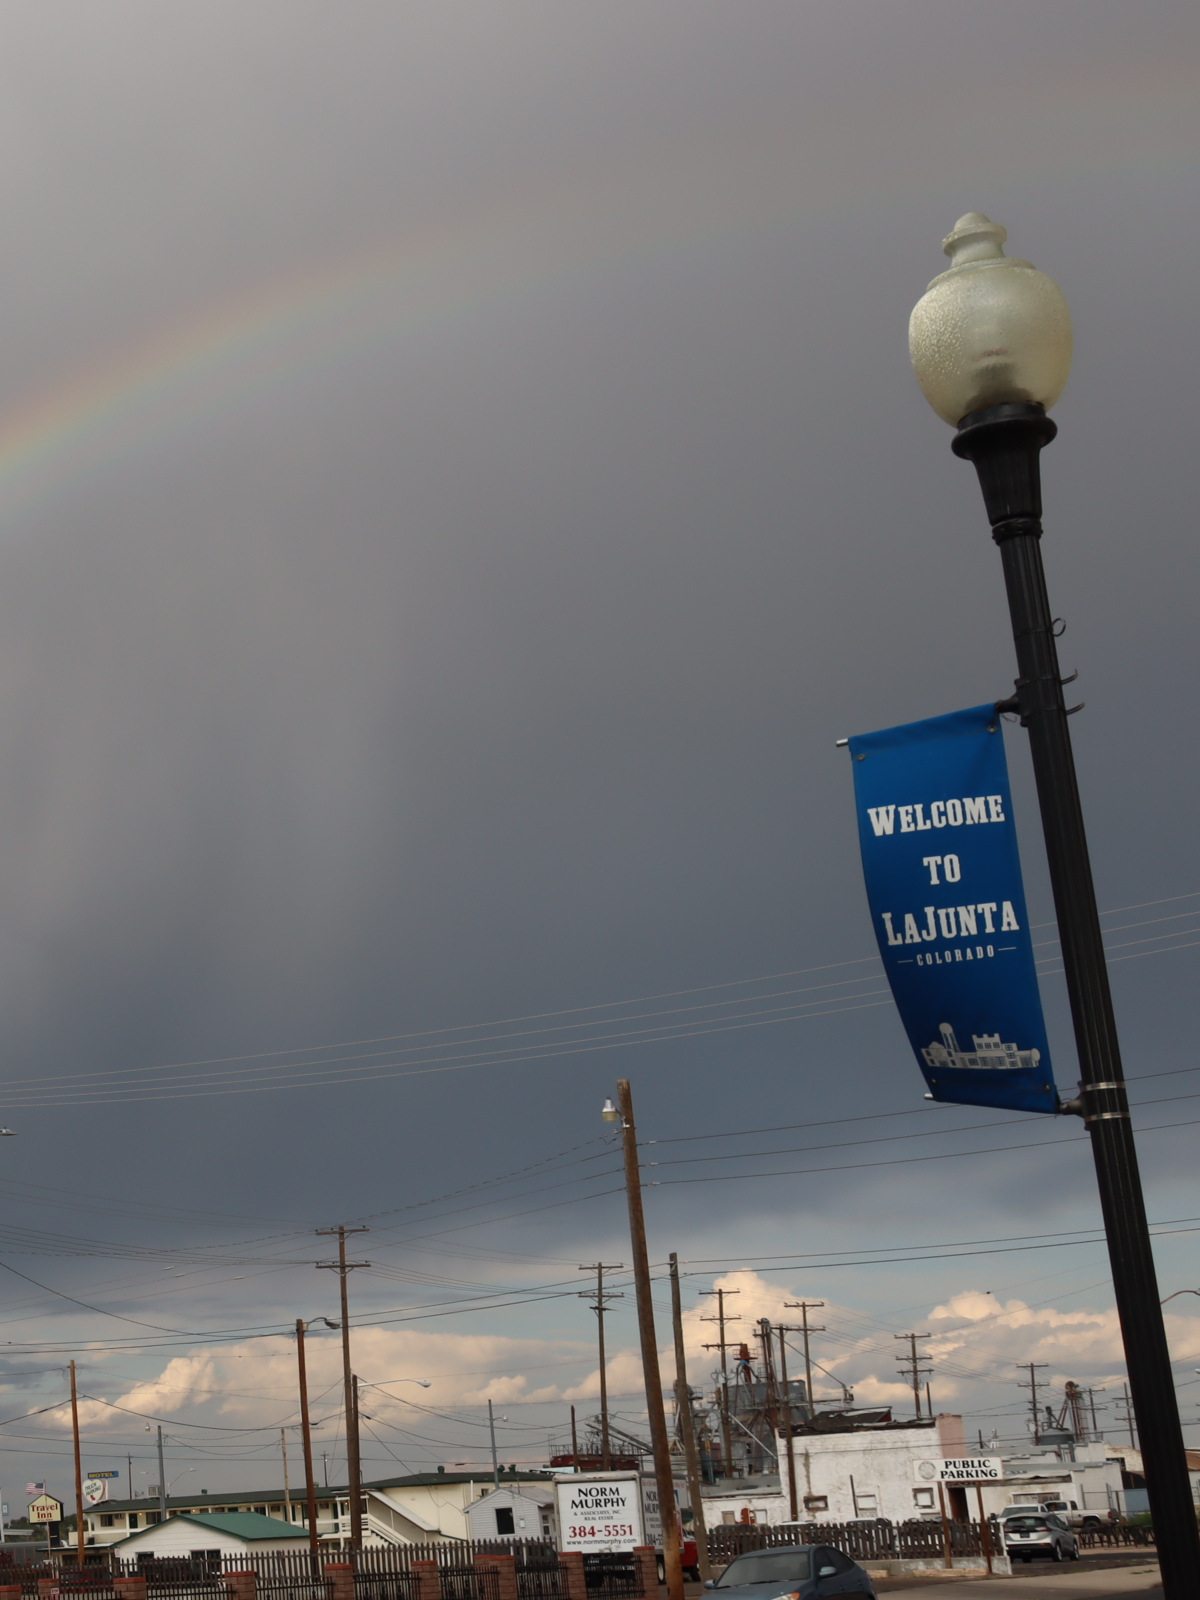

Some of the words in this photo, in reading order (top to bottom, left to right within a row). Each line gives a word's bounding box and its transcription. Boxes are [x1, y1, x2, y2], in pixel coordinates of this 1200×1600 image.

[867, 795, 1005, 836] WELCOME
[923, 854, 961, 885] TO
[917, 945, 995, 966] COLORADO
[944, 1459, 991, 1469] PUBLIC
[940, 1469, 998, 1479] PARKING
[578, 1487, 620, 1498] NORM
[646, 1490, 658, 1501] NOR
[31, 1503, 58, 1512] Travel
[571, 1497, 627, 1509] MURPHY
[645, 1503, 660, 1514] MURP
[37, 1511, 53, 1519] Inn
[569, 1524, 633, 1538] 384-5551
